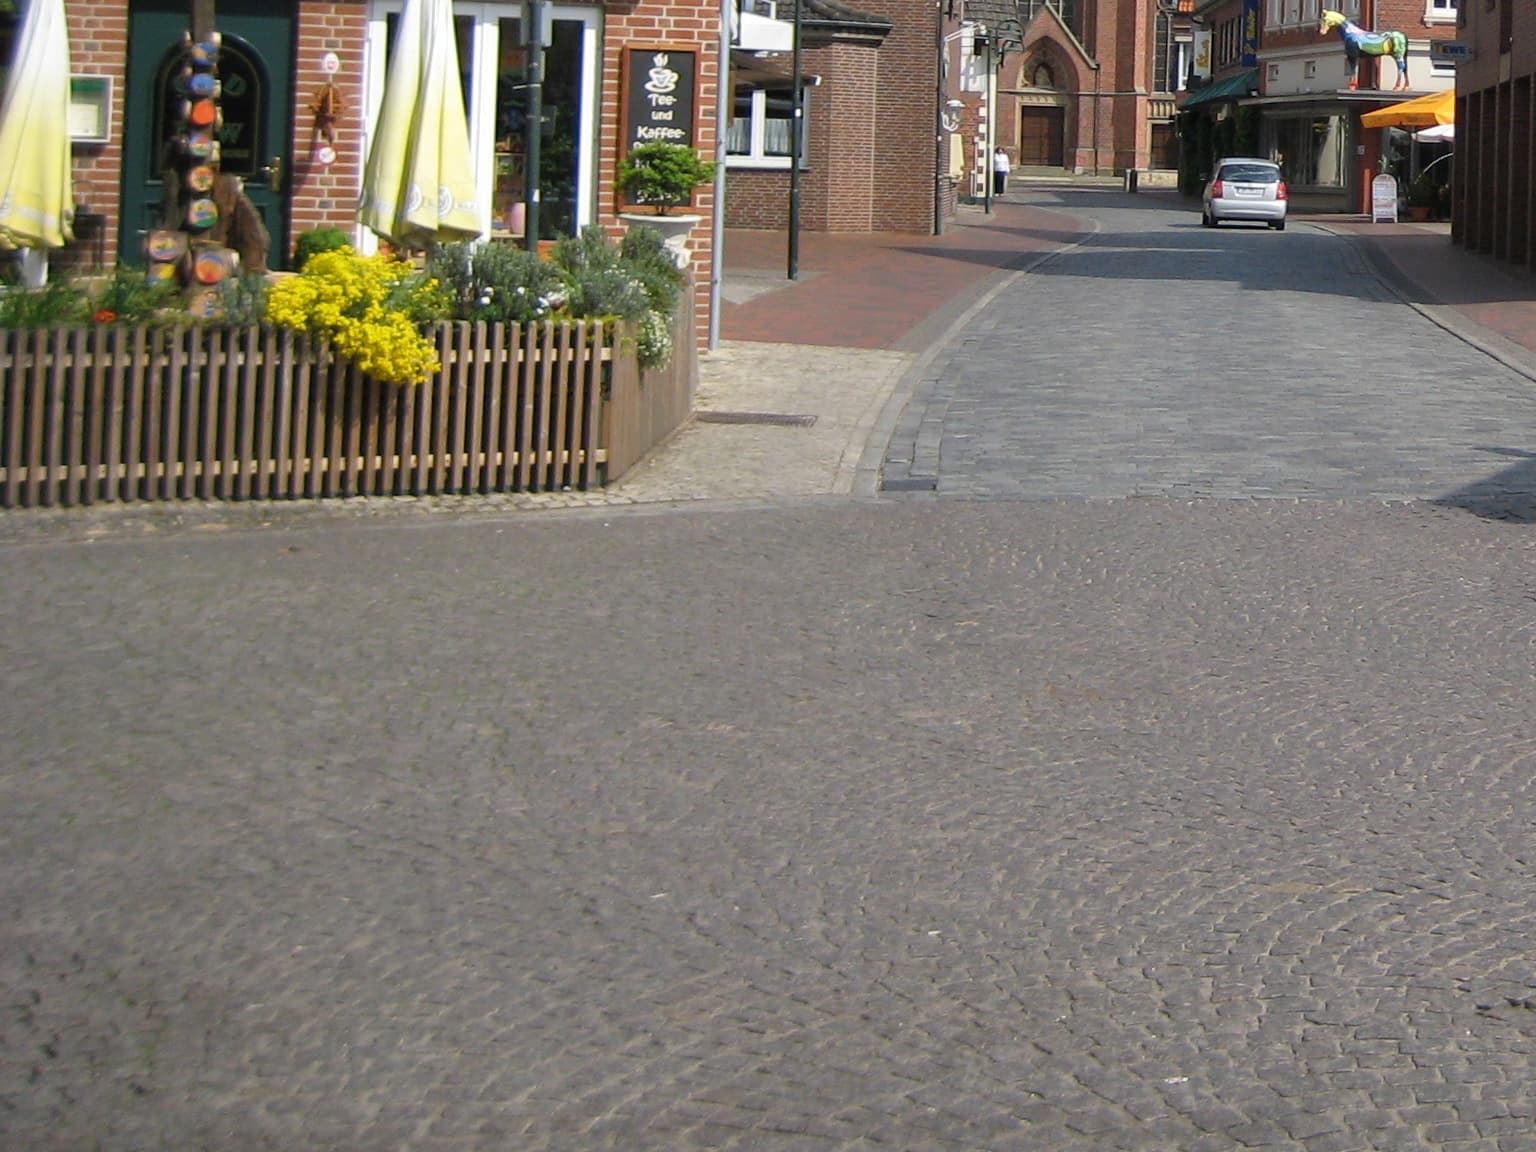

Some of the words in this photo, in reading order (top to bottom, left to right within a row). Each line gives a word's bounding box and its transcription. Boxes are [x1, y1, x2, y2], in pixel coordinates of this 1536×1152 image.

[647, 93, 677, 107] Tee-
[651, 110, 673, 121] und
[637, 125, 686, 139] Kaffee-
